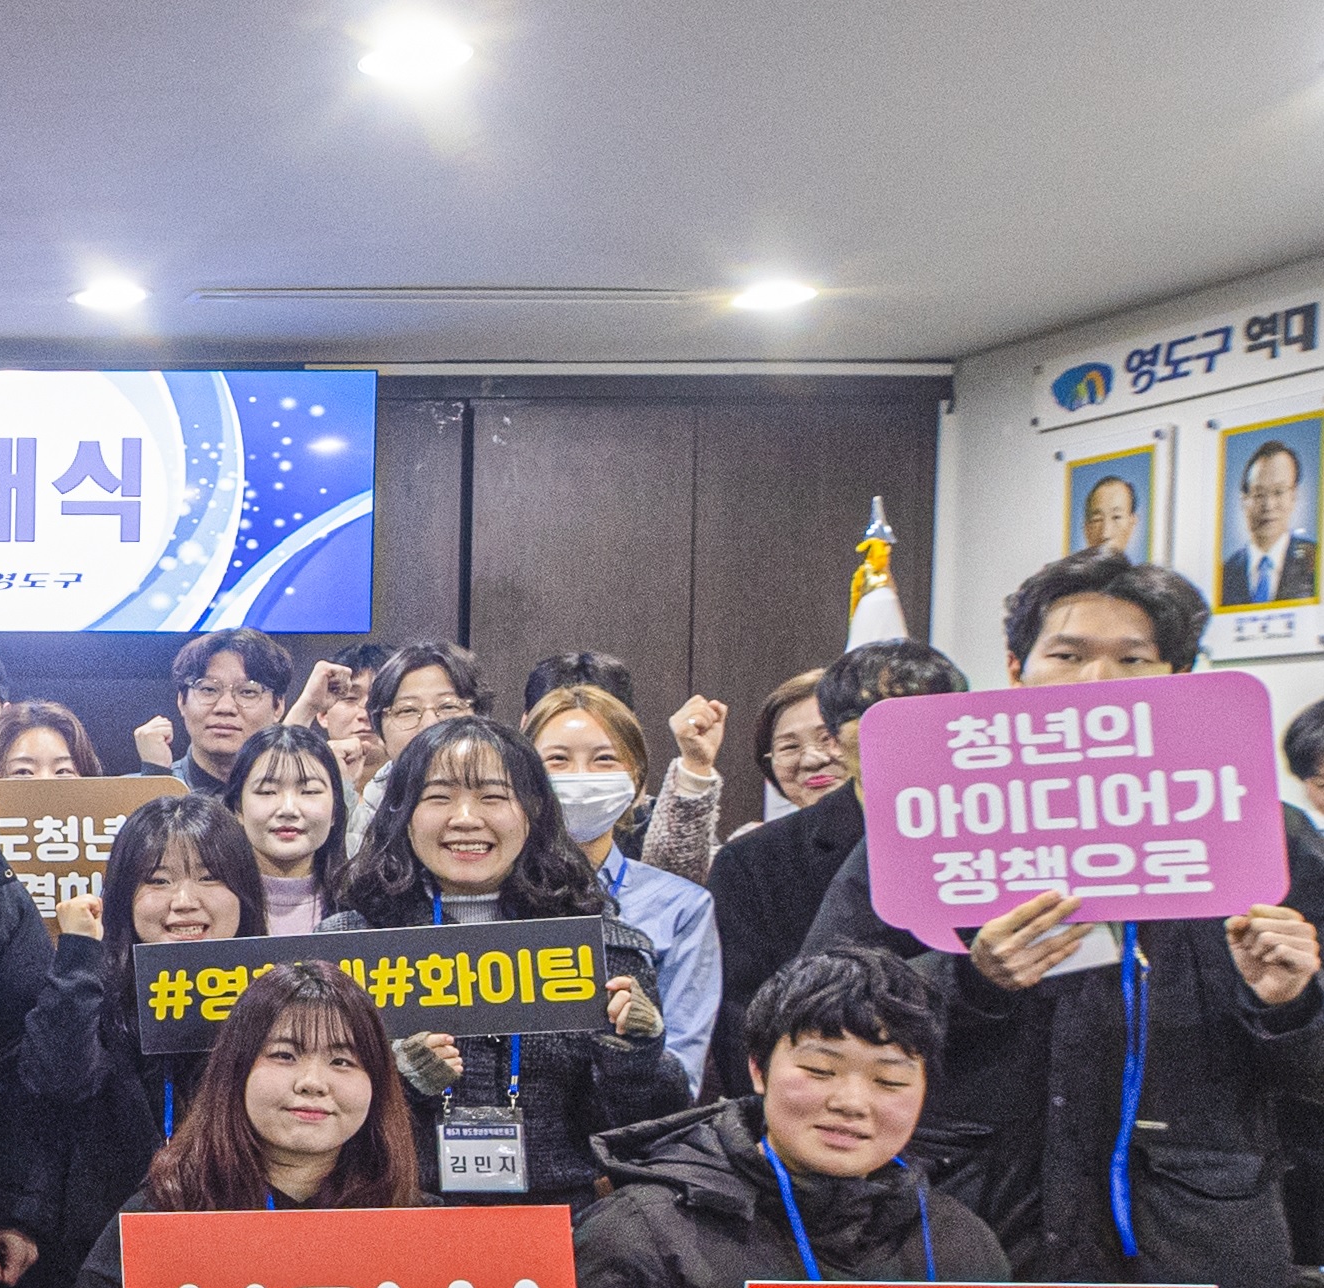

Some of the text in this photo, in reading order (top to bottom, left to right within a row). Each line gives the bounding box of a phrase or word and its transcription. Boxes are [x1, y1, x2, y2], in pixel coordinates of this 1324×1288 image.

[1125, 302, 1319, 394] 영도구 역대
[946, 701, 1154, 771] 청년의
[894, 766, 1246, 839] 아이디어가
[932, 838, 1214, 905] 정책으로
